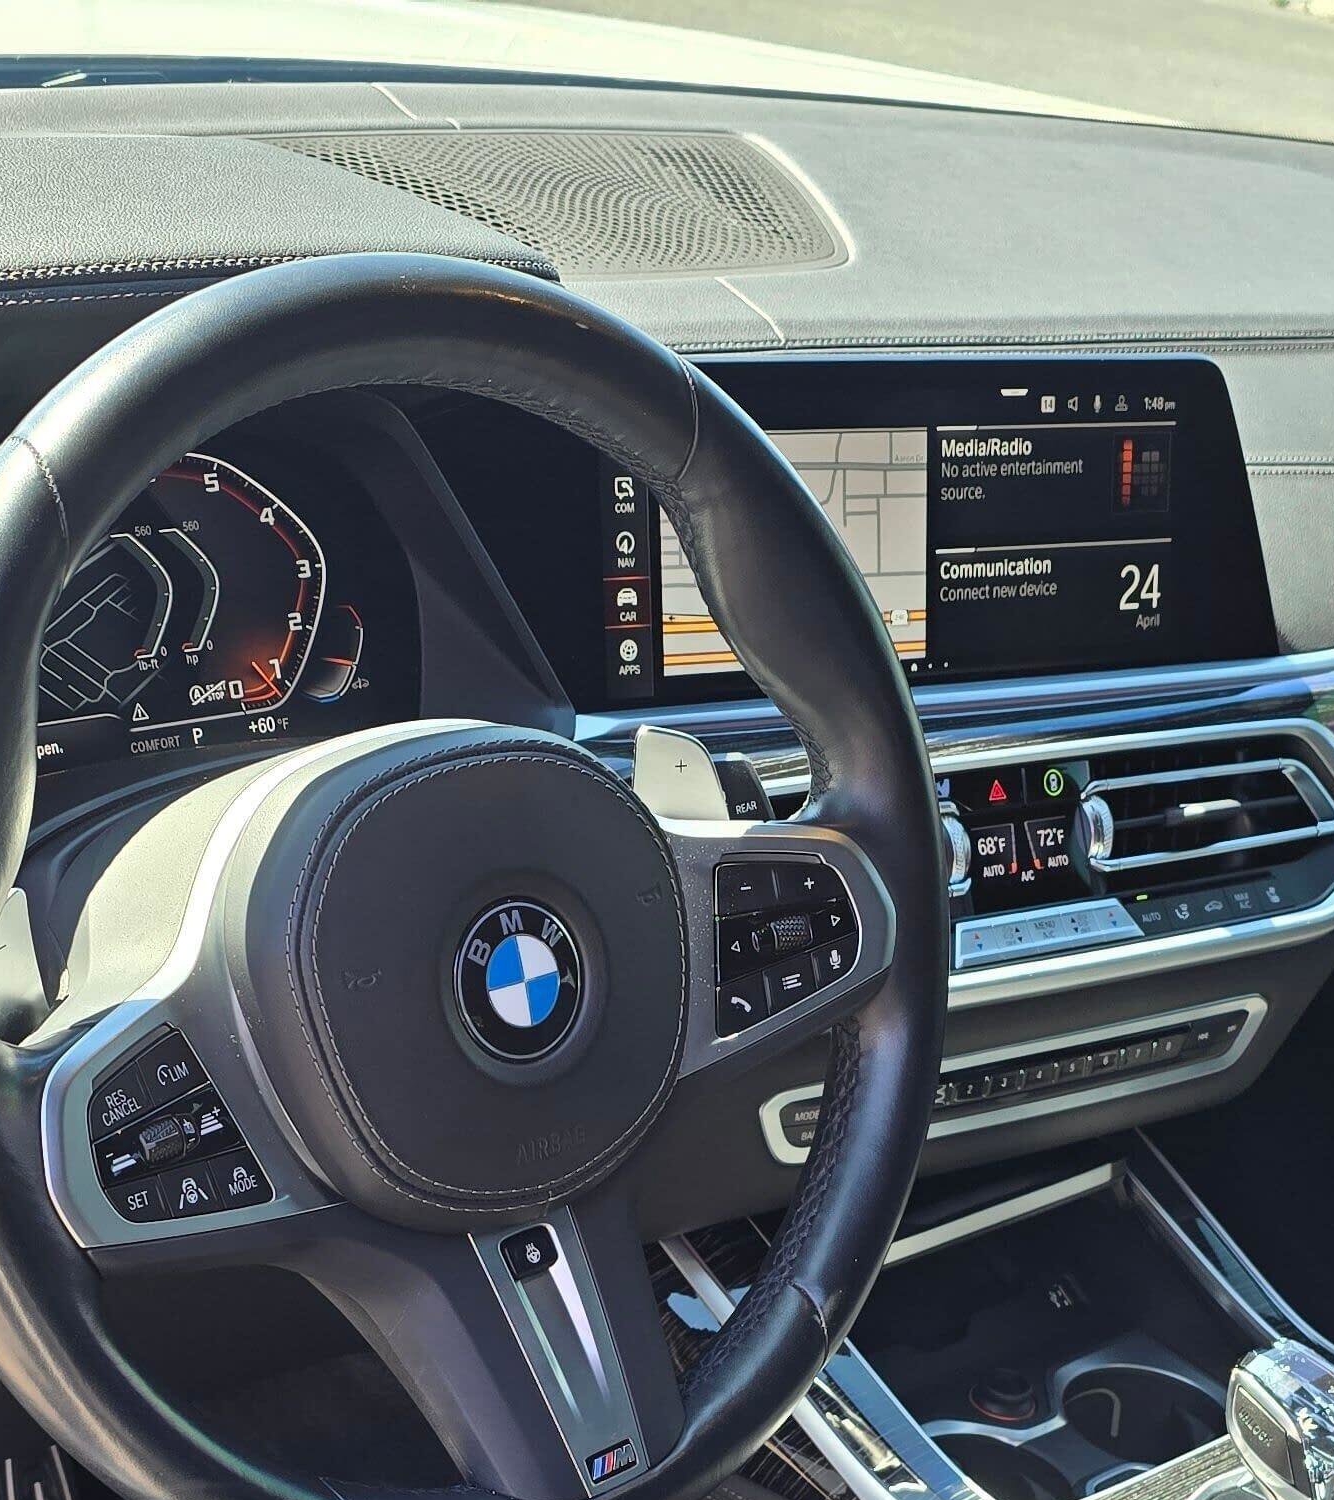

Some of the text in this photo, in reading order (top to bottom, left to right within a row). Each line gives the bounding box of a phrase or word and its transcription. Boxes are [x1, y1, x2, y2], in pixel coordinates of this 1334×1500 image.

[1143, 396, 1176, 412] 1:48 pm
[941, 437, 1033, 458] Media/Radio
[941, 458, 1084, 478] No active entertainment
[204, 473, 220, 493] 5
[940, 485, 986, 501] source.
[260, 507, 275, 526] 4
[615, 502, 635, 514] COM
[134, 525, 152, 537] 560
[183, 520, 200, 532] 560
[296, 559, 312, 579] 3
[617, 557, 636, 568] NAV
[940, 558, 1052, 580] Communication
[939, 580, 1058, 602] Connect new device
[1119, 564, 1161, 611] 24
[288, 612, 302, 631] 2
[619, 611, 637, 622] CAR
[1135, 613, 1161, 630] April
[160, 646, 167, 657] 0
[207, 640, 213, 651] 0
[138, 659, 160, 673] lb-ft
[186, 653, 199, 666] hp
[269, 659, 282, 679] 1
[618, 665, 641, 676] APPS
[229, 680, 244, 699] 0
[249, 716, 276, 734] +60
[130, 735, 181, 754] COMFORT
[192, 727, 203, 745] P
[36, 742, 64, 760] pen.
[735, 801, 758, 815] REAR
[983, 863, 1005, 878] AUTO
[1047, 854, 1069, 869] AUTO
[1021, 870, 1035, 882] A/C
[1142, 911, 1161, 923] AUTO
[467, 909, 564, 967] BMW
[169, 1062, 190, 1083] LIM
[105, 1089, 127, 1109] RES
[102, 1097, 142, 1127] CANCEL
[794, 1109, 820, 1122] MODE
[228, 1175, 258, 1196] MODE
[127, 1190, 149, 1211] SET
